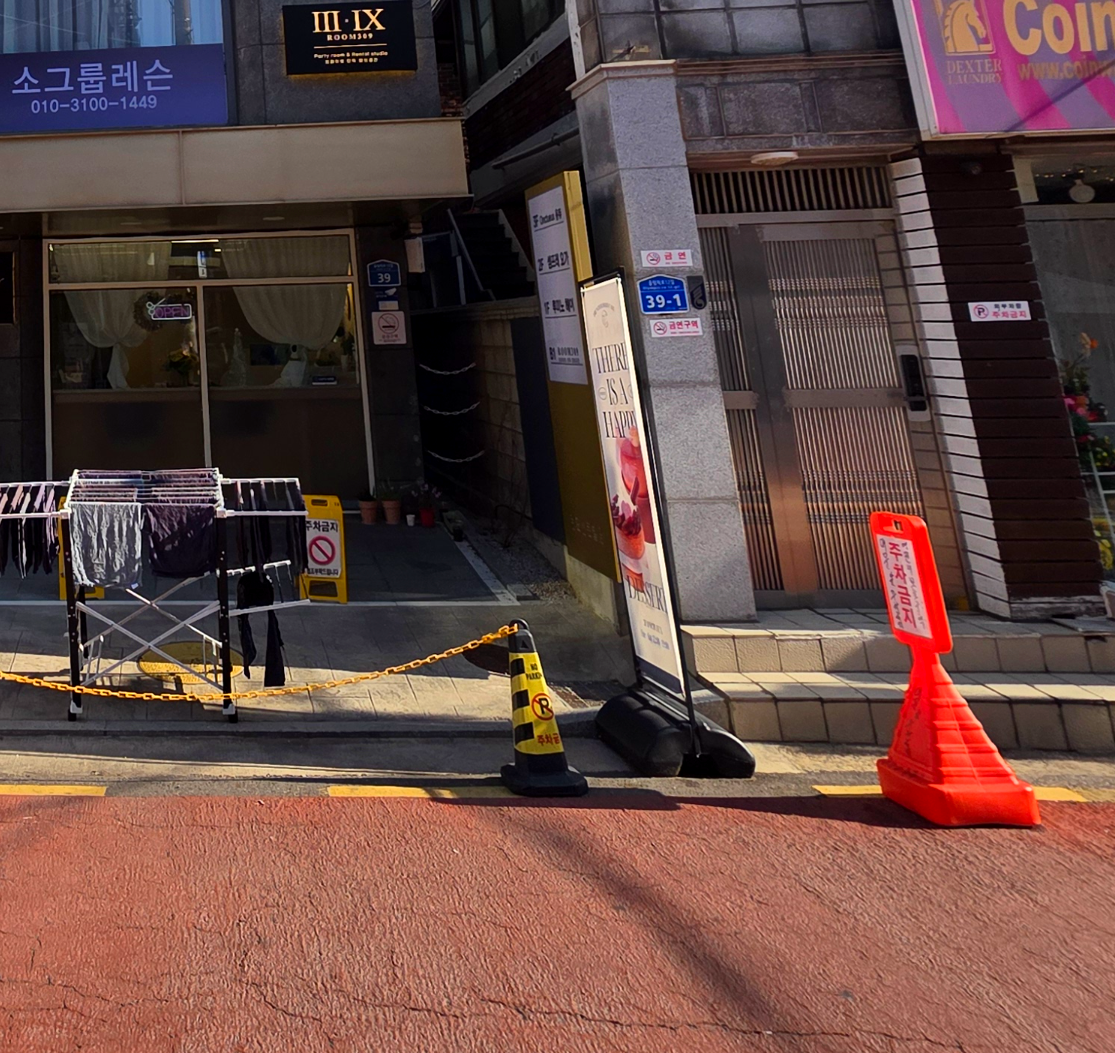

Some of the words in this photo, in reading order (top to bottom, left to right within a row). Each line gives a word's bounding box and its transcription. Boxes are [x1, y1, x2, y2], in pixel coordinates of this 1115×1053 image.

[327, 33, 374, 42] ROOM309
[946, 58, 1002, 75] DEXTER
[11, 59, 173, 94] 소그룹레슨
[948, 72, 1002, 85] LAUNDRY
[31, 95, 157, 114] 010-3100-1449
[377, 273, 391, 284] 39
[645, 293, 682, 309] 39-1
[992, 310, 1027, 319] 주차금지
[668, 320, 699, 330] 금연구역
[592, 341, 629, 374] THERE
[606, 377, 619, 406] IS
[620, 377, 629, 405] A
[888, 542, 917, 629] 주차금지
[537, 732, 560, 746] 주차금
